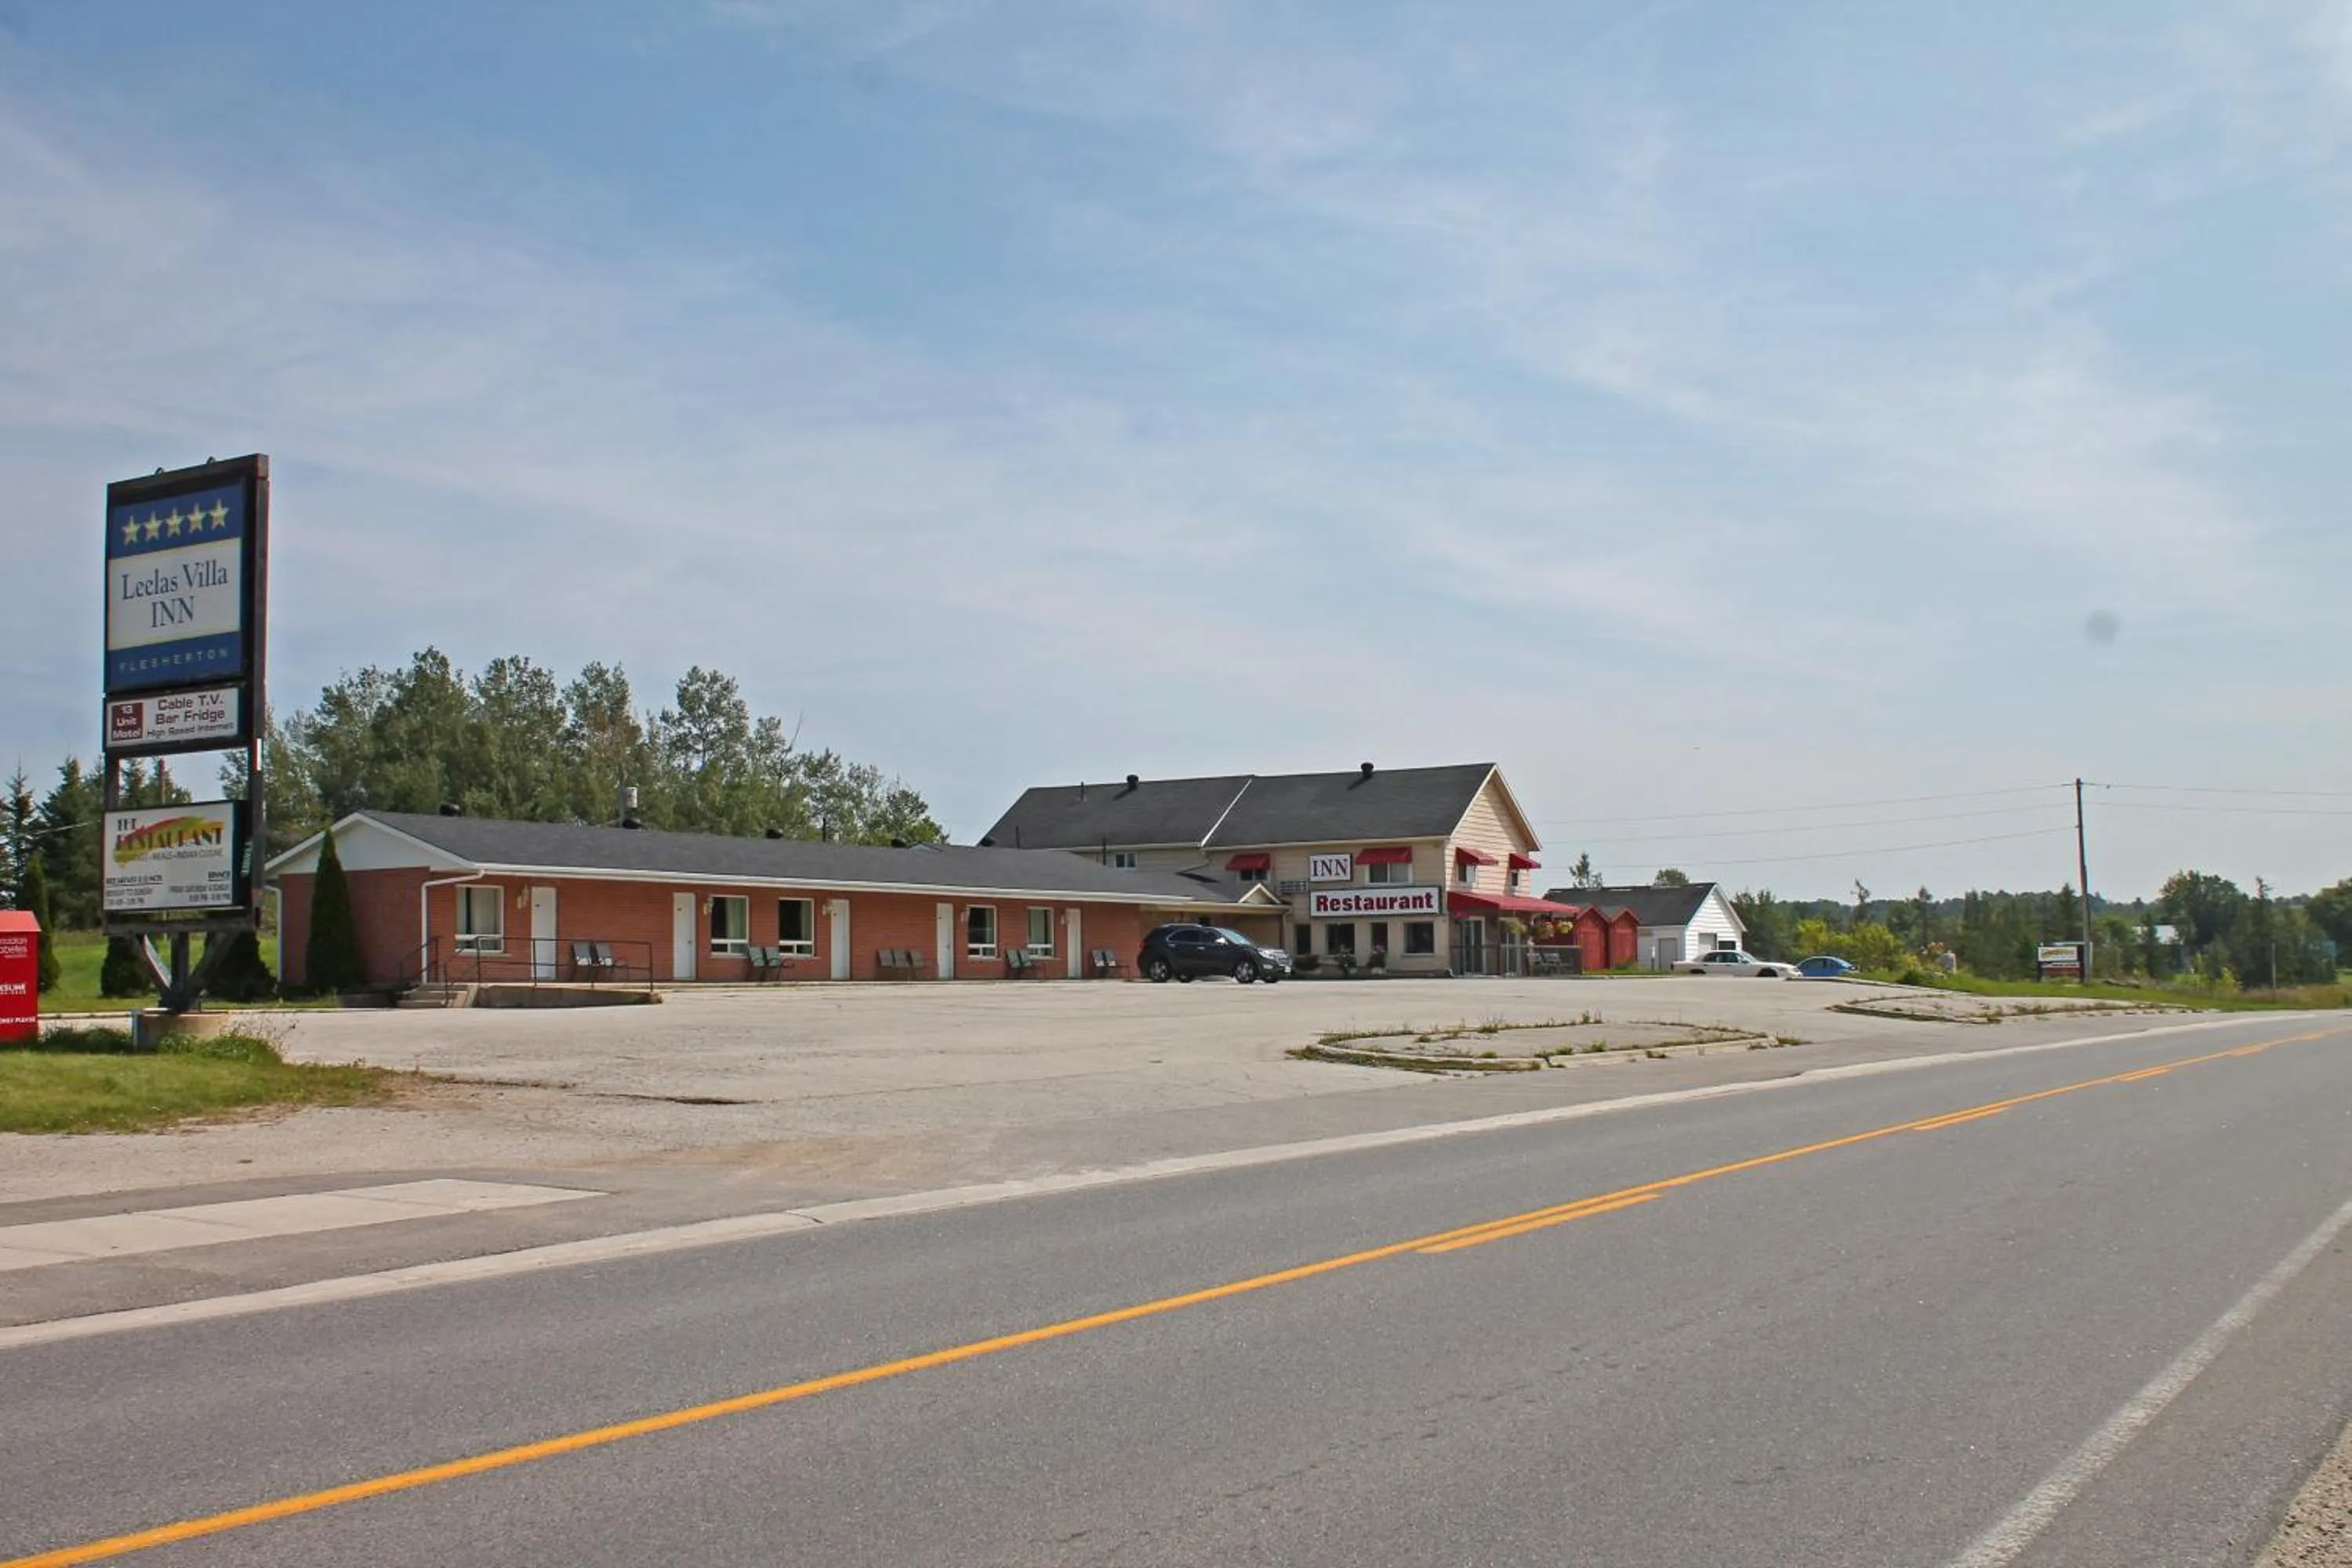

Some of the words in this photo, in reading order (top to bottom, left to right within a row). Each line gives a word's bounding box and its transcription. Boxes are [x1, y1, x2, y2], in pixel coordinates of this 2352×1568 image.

[122, 568, 178, 600] Leelas
[182, 559, 228, 588] Villa
[151, 596, 194, 628] INN
[158, 697, 194, 711] Cable
[198, 693, 223, 706] T.V.
[156, 713, 180, 724] Bar
[183, 710, 225, 723] Fridge
[113, 728, 141, 739] Motel
[147, 728, 166, 739] High
[1313, 859, 1348, 877] INN
[1316, 892, 1433, 912] Restaurant
